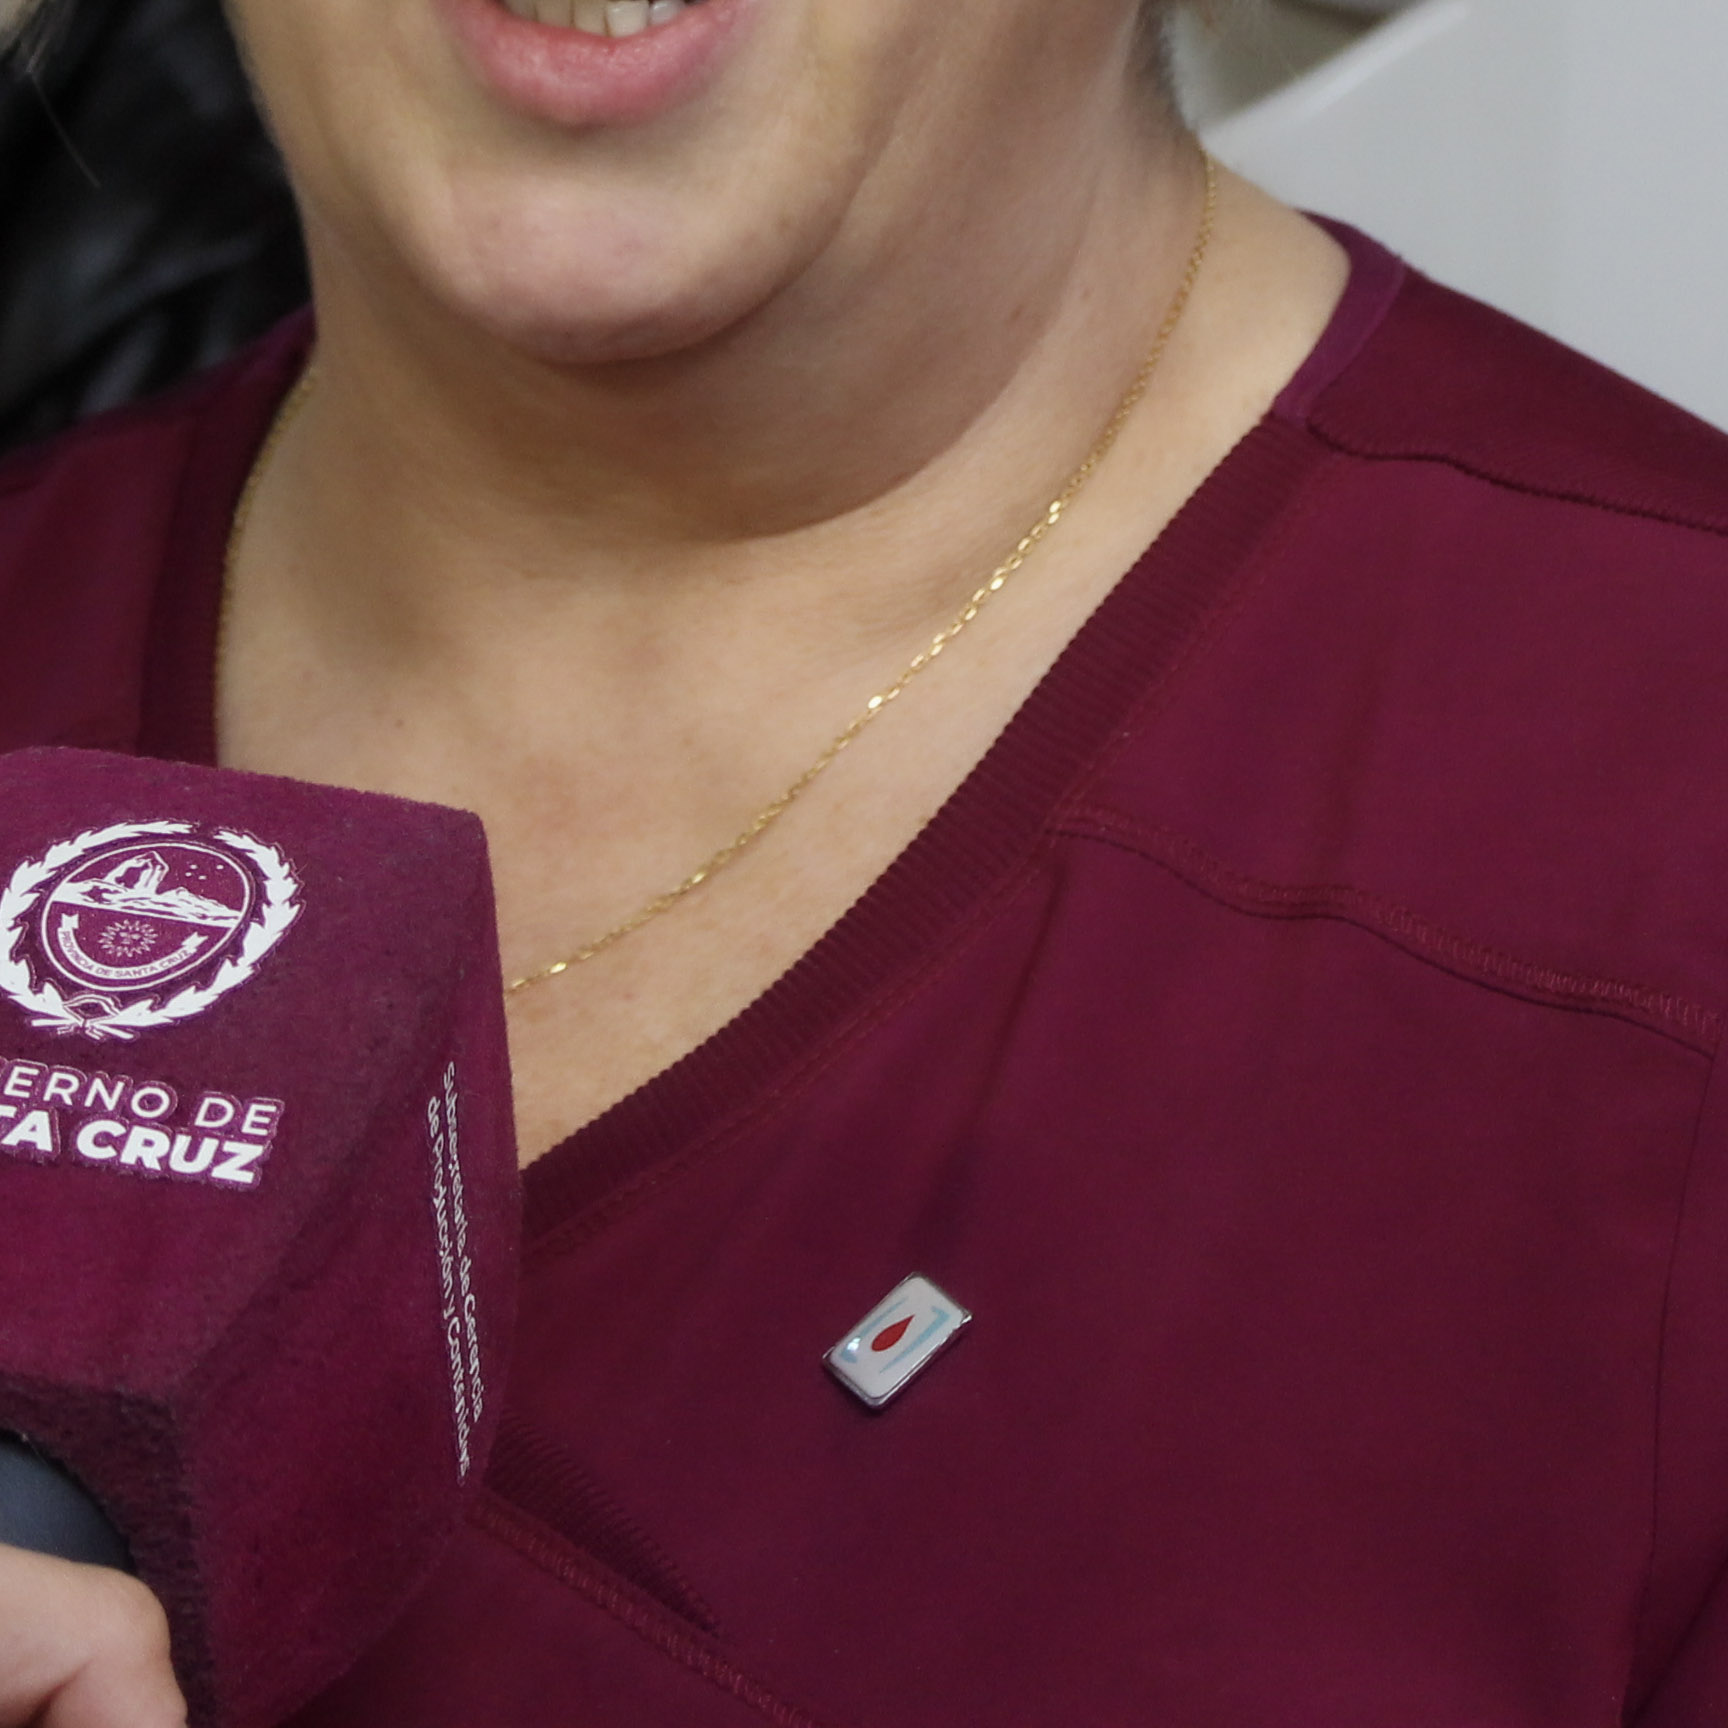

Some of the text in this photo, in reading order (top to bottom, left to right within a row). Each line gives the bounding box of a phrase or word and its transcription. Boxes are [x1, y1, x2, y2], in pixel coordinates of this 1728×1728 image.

[96, 967, 112, 978] DE
[116, 966, 158, 978] SANTA
[160, 950, 190, 969] CRUZ
[194, 1096, 278, 1137] DE
[76, 1119, 265, 1185] CRUZ
[427, 1095, 441, 1139] de
[443, 1293, 456, 1321] y
[459, 1255, 472, 1297] de
[464, 1292, 484, 1423] Gerencia
